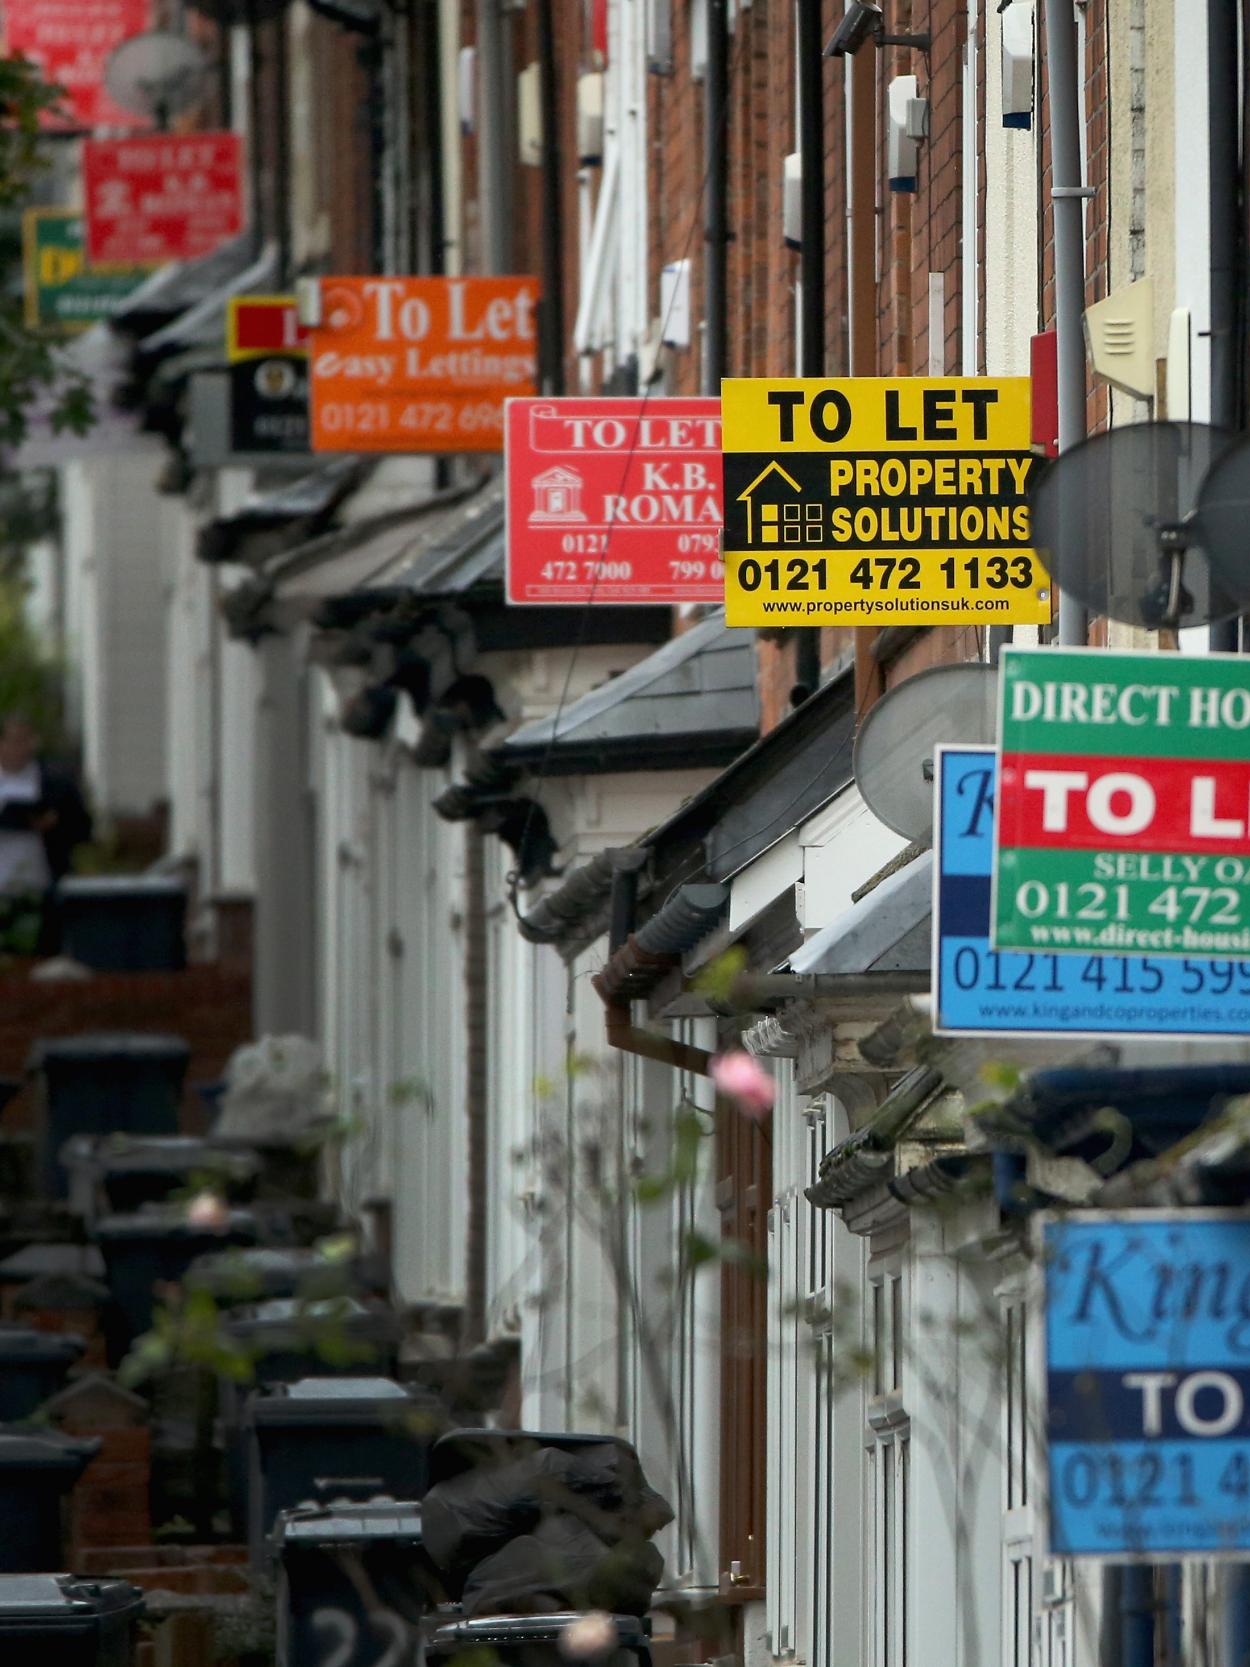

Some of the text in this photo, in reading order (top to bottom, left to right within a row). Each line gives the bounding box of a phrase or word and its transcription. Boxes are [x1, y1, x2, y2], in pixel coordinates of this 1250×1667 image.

[362, 282, 430, 340] To
[448, 282, 534, 340] Let
[314, 352, 397, 384] easy
[406, 349, 536, 386] Lettings
[321, 403, 389, 431] 0121
[401, 403, 450, 431] 472
[564, 419, 722, 448] TO LET
[768, 389, 998, 443] TO LET
[643, 462, 717, 490] K.B.
[830, 458, 1032, 497] PROPERTY
[603, 495, 723, 523] ROMA
[831, 505, 1030, 543] SOLUTIONS
[562, 534, 608, 553] 0121
[541, 561, 577, 580] 472
[584, 561, 632, 580] 7000
[669, 561, 705, 580] 799
[738, 556, 1033, 591] 0121 472 1133
[763, 599, 1010, 616] www.propertysolutionsuk.com
[1011, 680, 1179, 727] DIRECT
[1025, 770, 1156, 835] TO
[1093, 853, 1208, 881] SELLY
[1016, 881, 1130, 921] 0121
[1148, 886, 1240, 925] 472
[954, 946, 1064, 991] 0121
[1081, 953, 1164, 993] 415
[1123, 1371, 1244, 1437] TO
[1063, 1451, 1198, 1508] 0121
